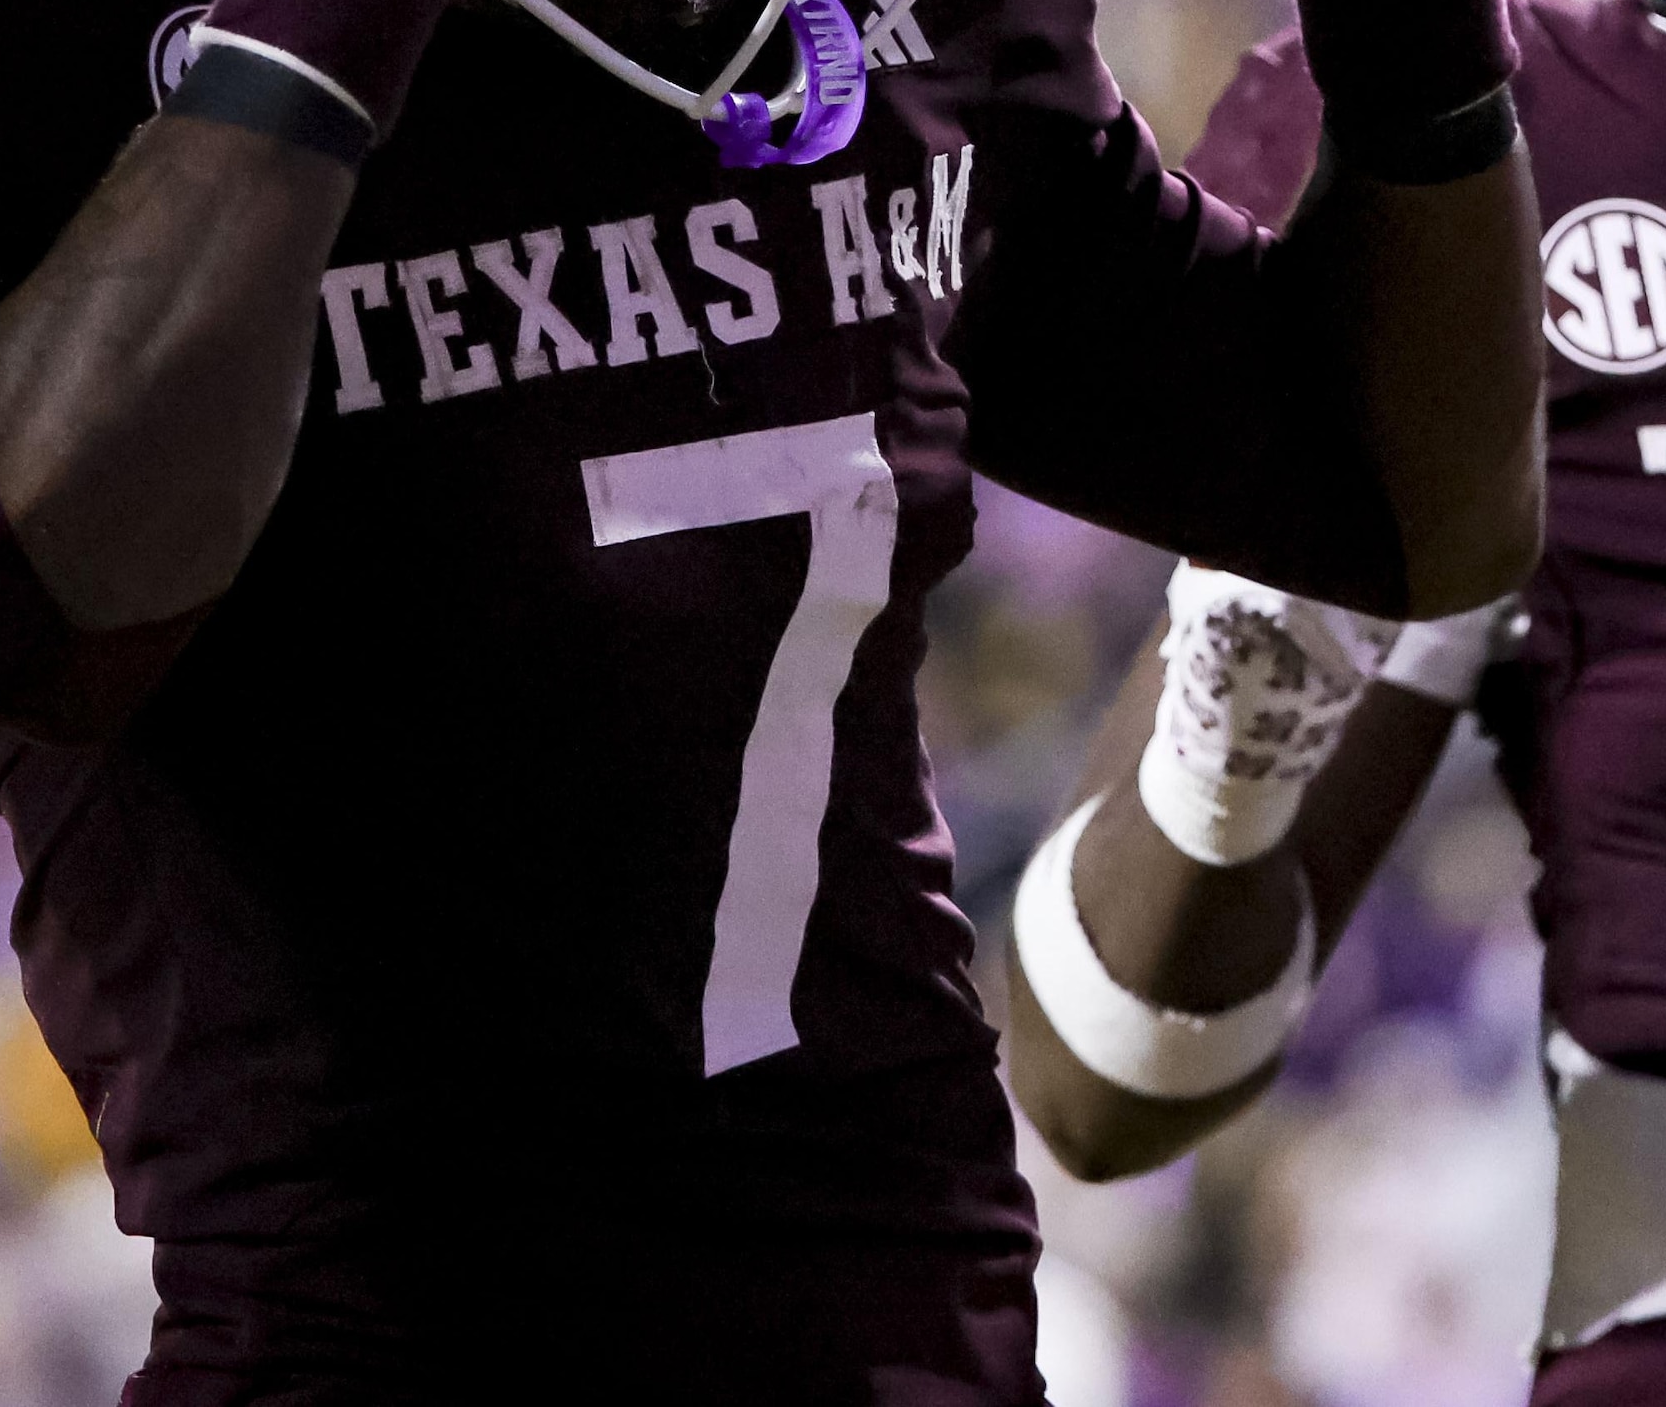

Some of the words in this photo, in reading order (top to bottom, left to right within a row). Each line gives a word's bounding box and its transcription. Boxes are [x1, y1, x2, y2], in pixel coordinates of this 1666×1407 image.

[321, 198, 780, 414] TEXAS
[810, 144, 974, 326] A&M
[580, 412, 898, 1077] 7
